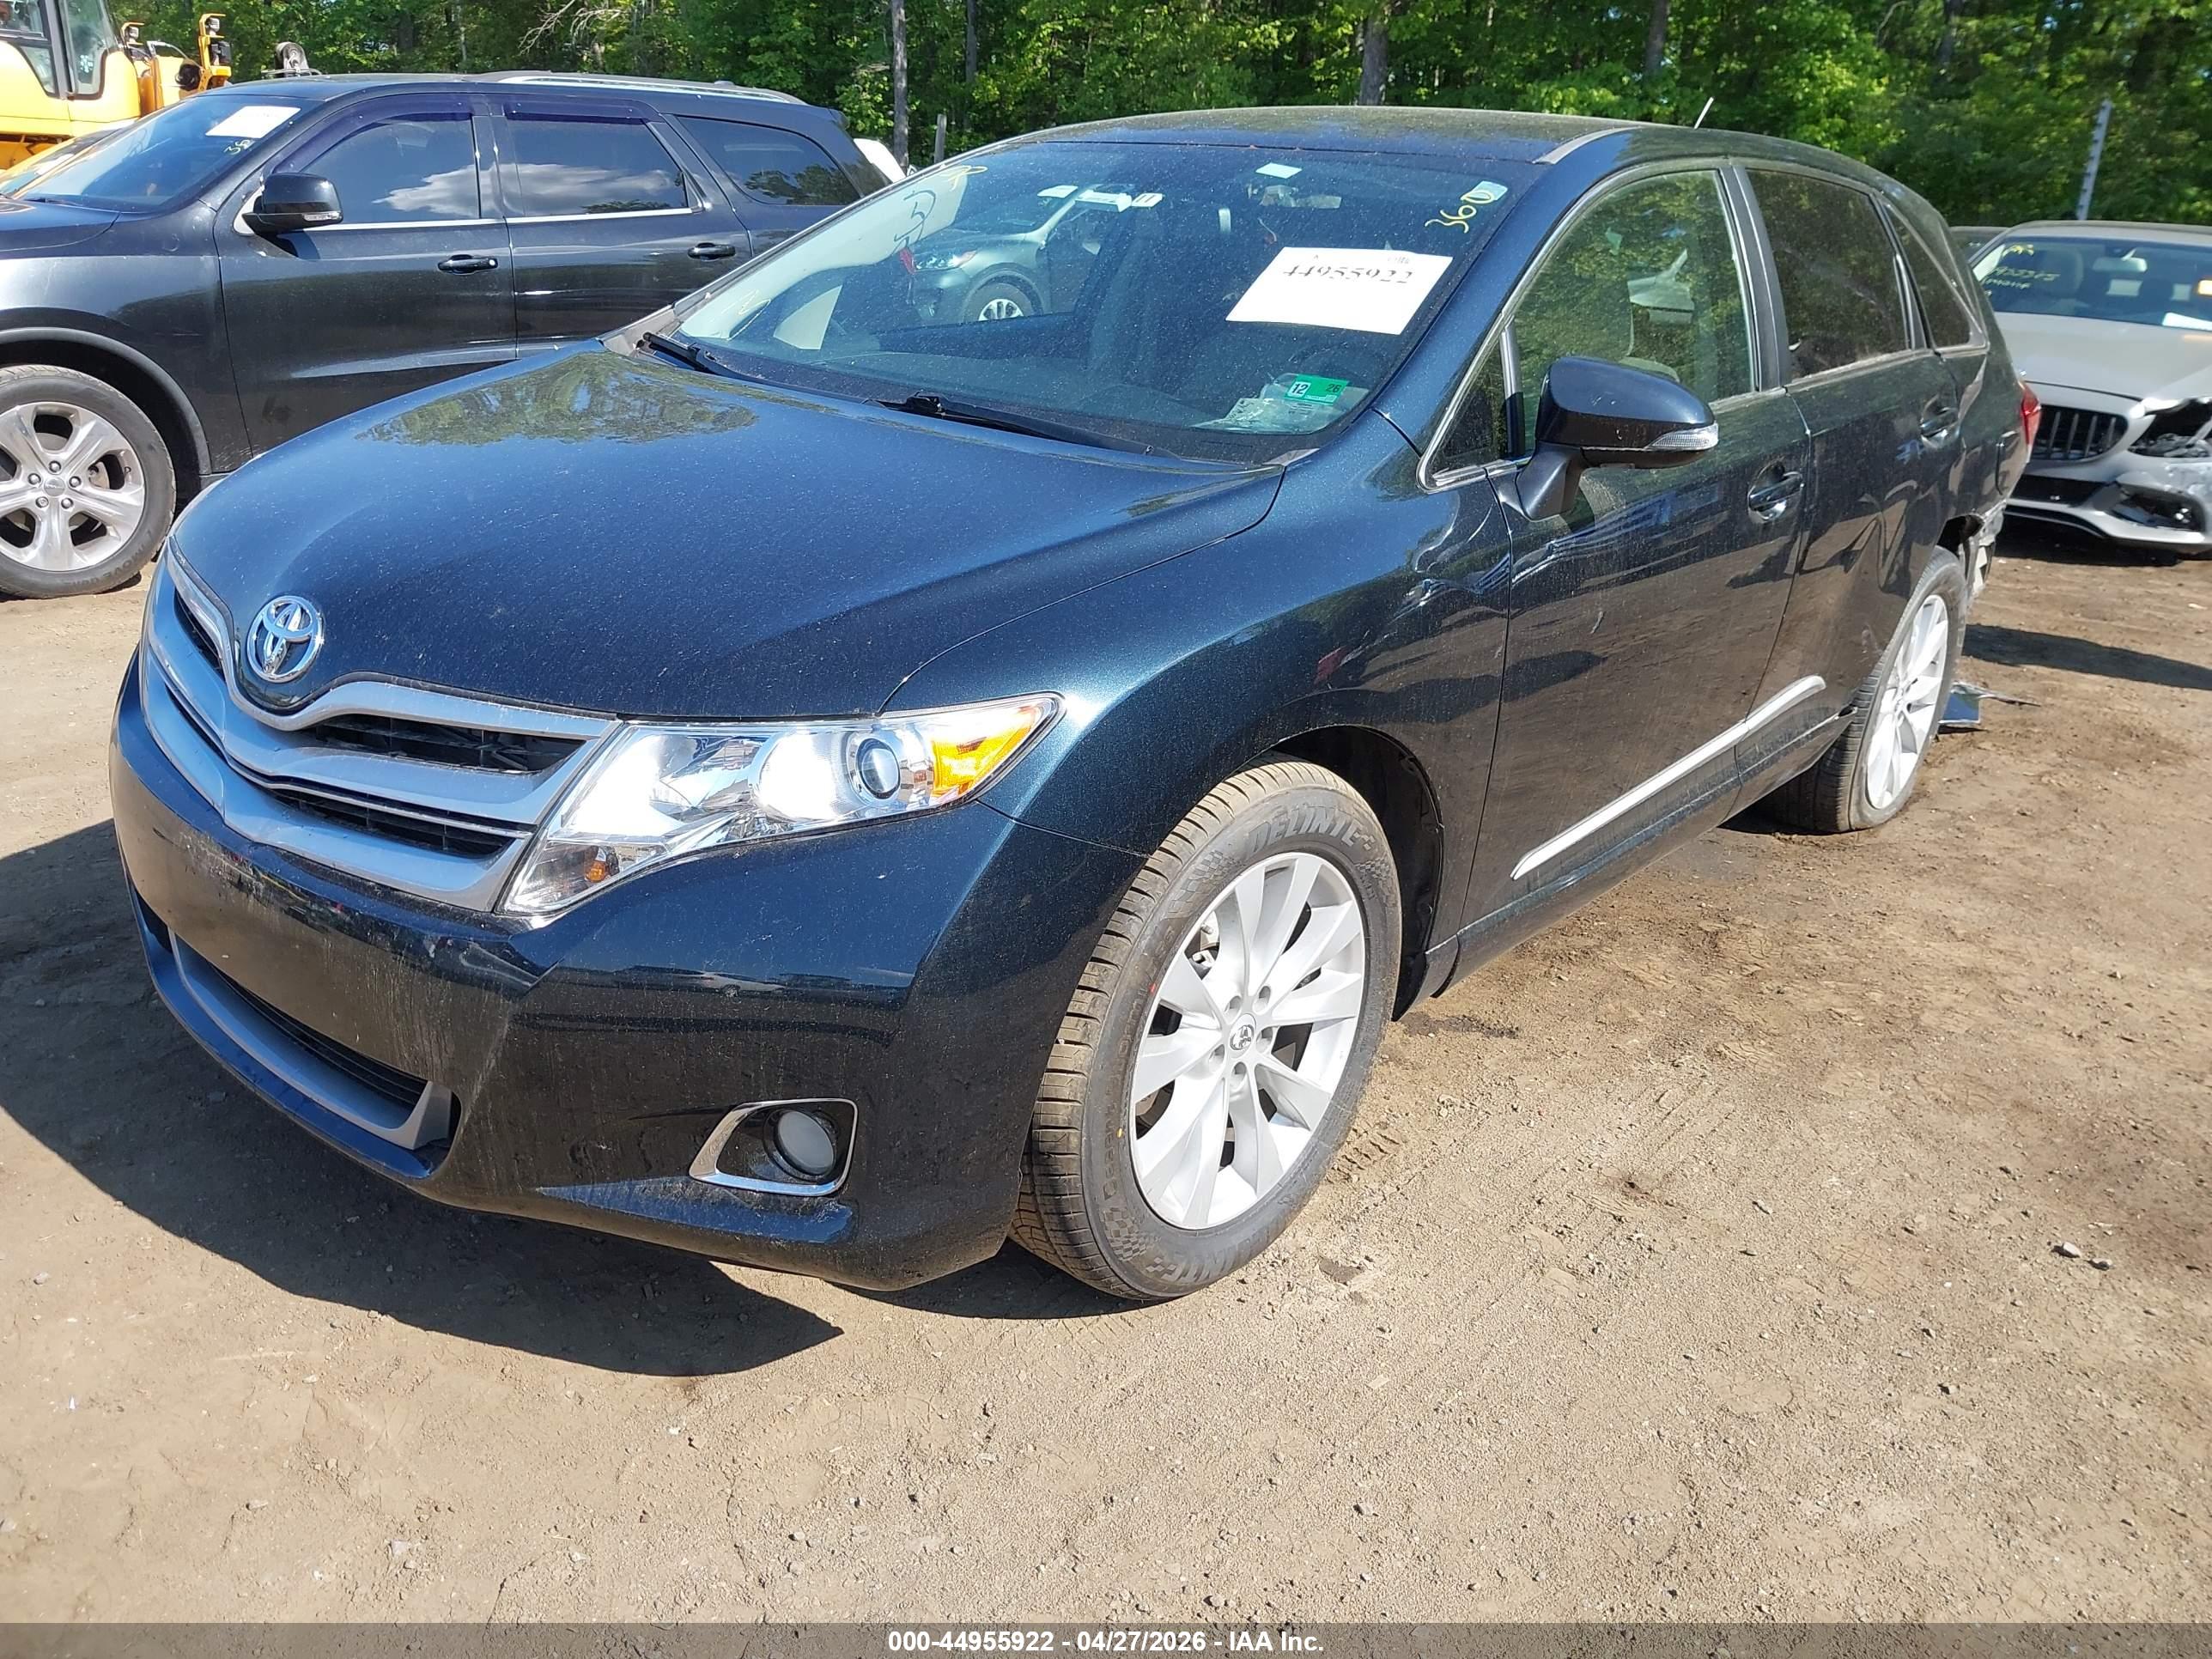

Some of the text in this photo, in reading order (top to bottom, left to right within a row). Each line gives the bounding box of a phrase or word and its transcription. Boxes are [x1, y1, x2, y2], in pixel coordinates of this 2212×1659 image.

[1283, 264, 1414, 283] 44955922
[1291, 381, 1309, 395] 12
[1248, 805, 1363, 852] DELINTE
